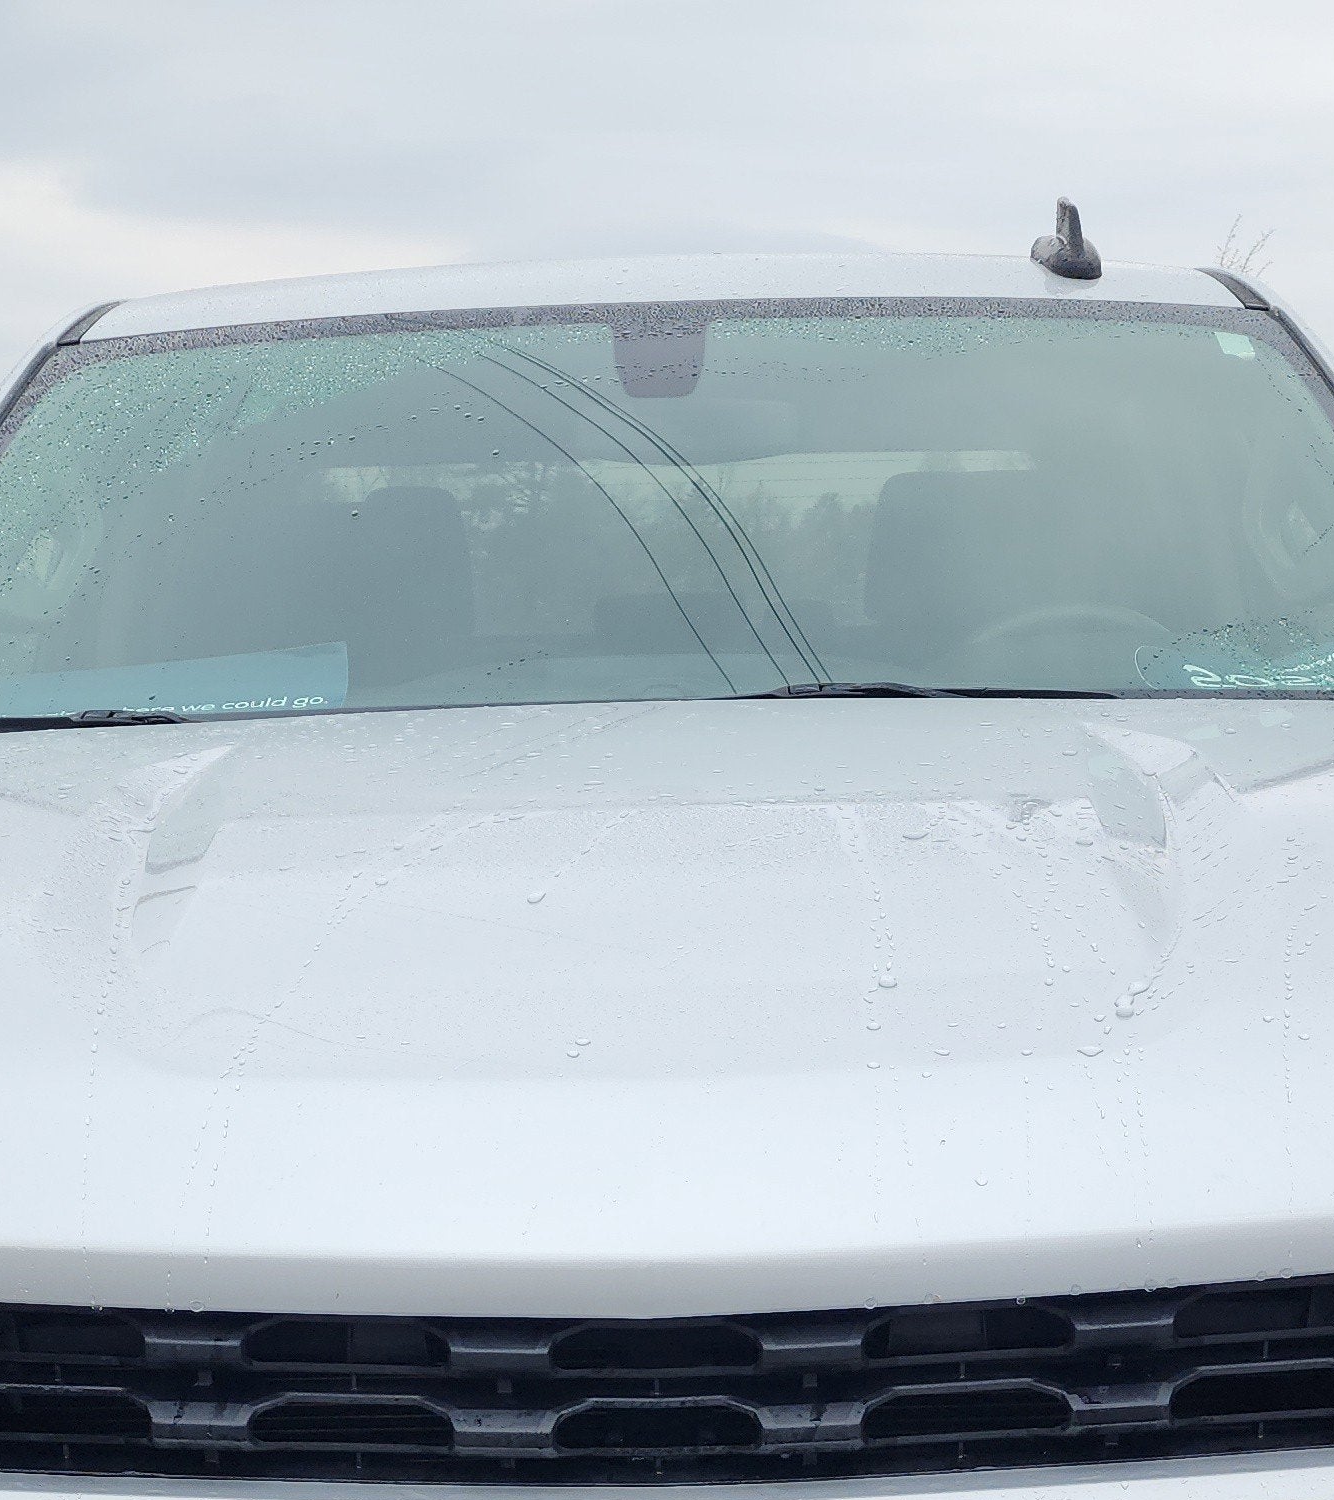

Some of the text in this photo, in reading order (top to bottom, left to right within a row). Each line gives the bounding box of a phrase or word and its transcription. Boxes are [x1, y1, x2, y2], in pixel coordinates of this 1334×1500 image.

[182, 703, 215, 712] we
[222, 696, 288, 710] could
[292, 696, 328, 709] go.
